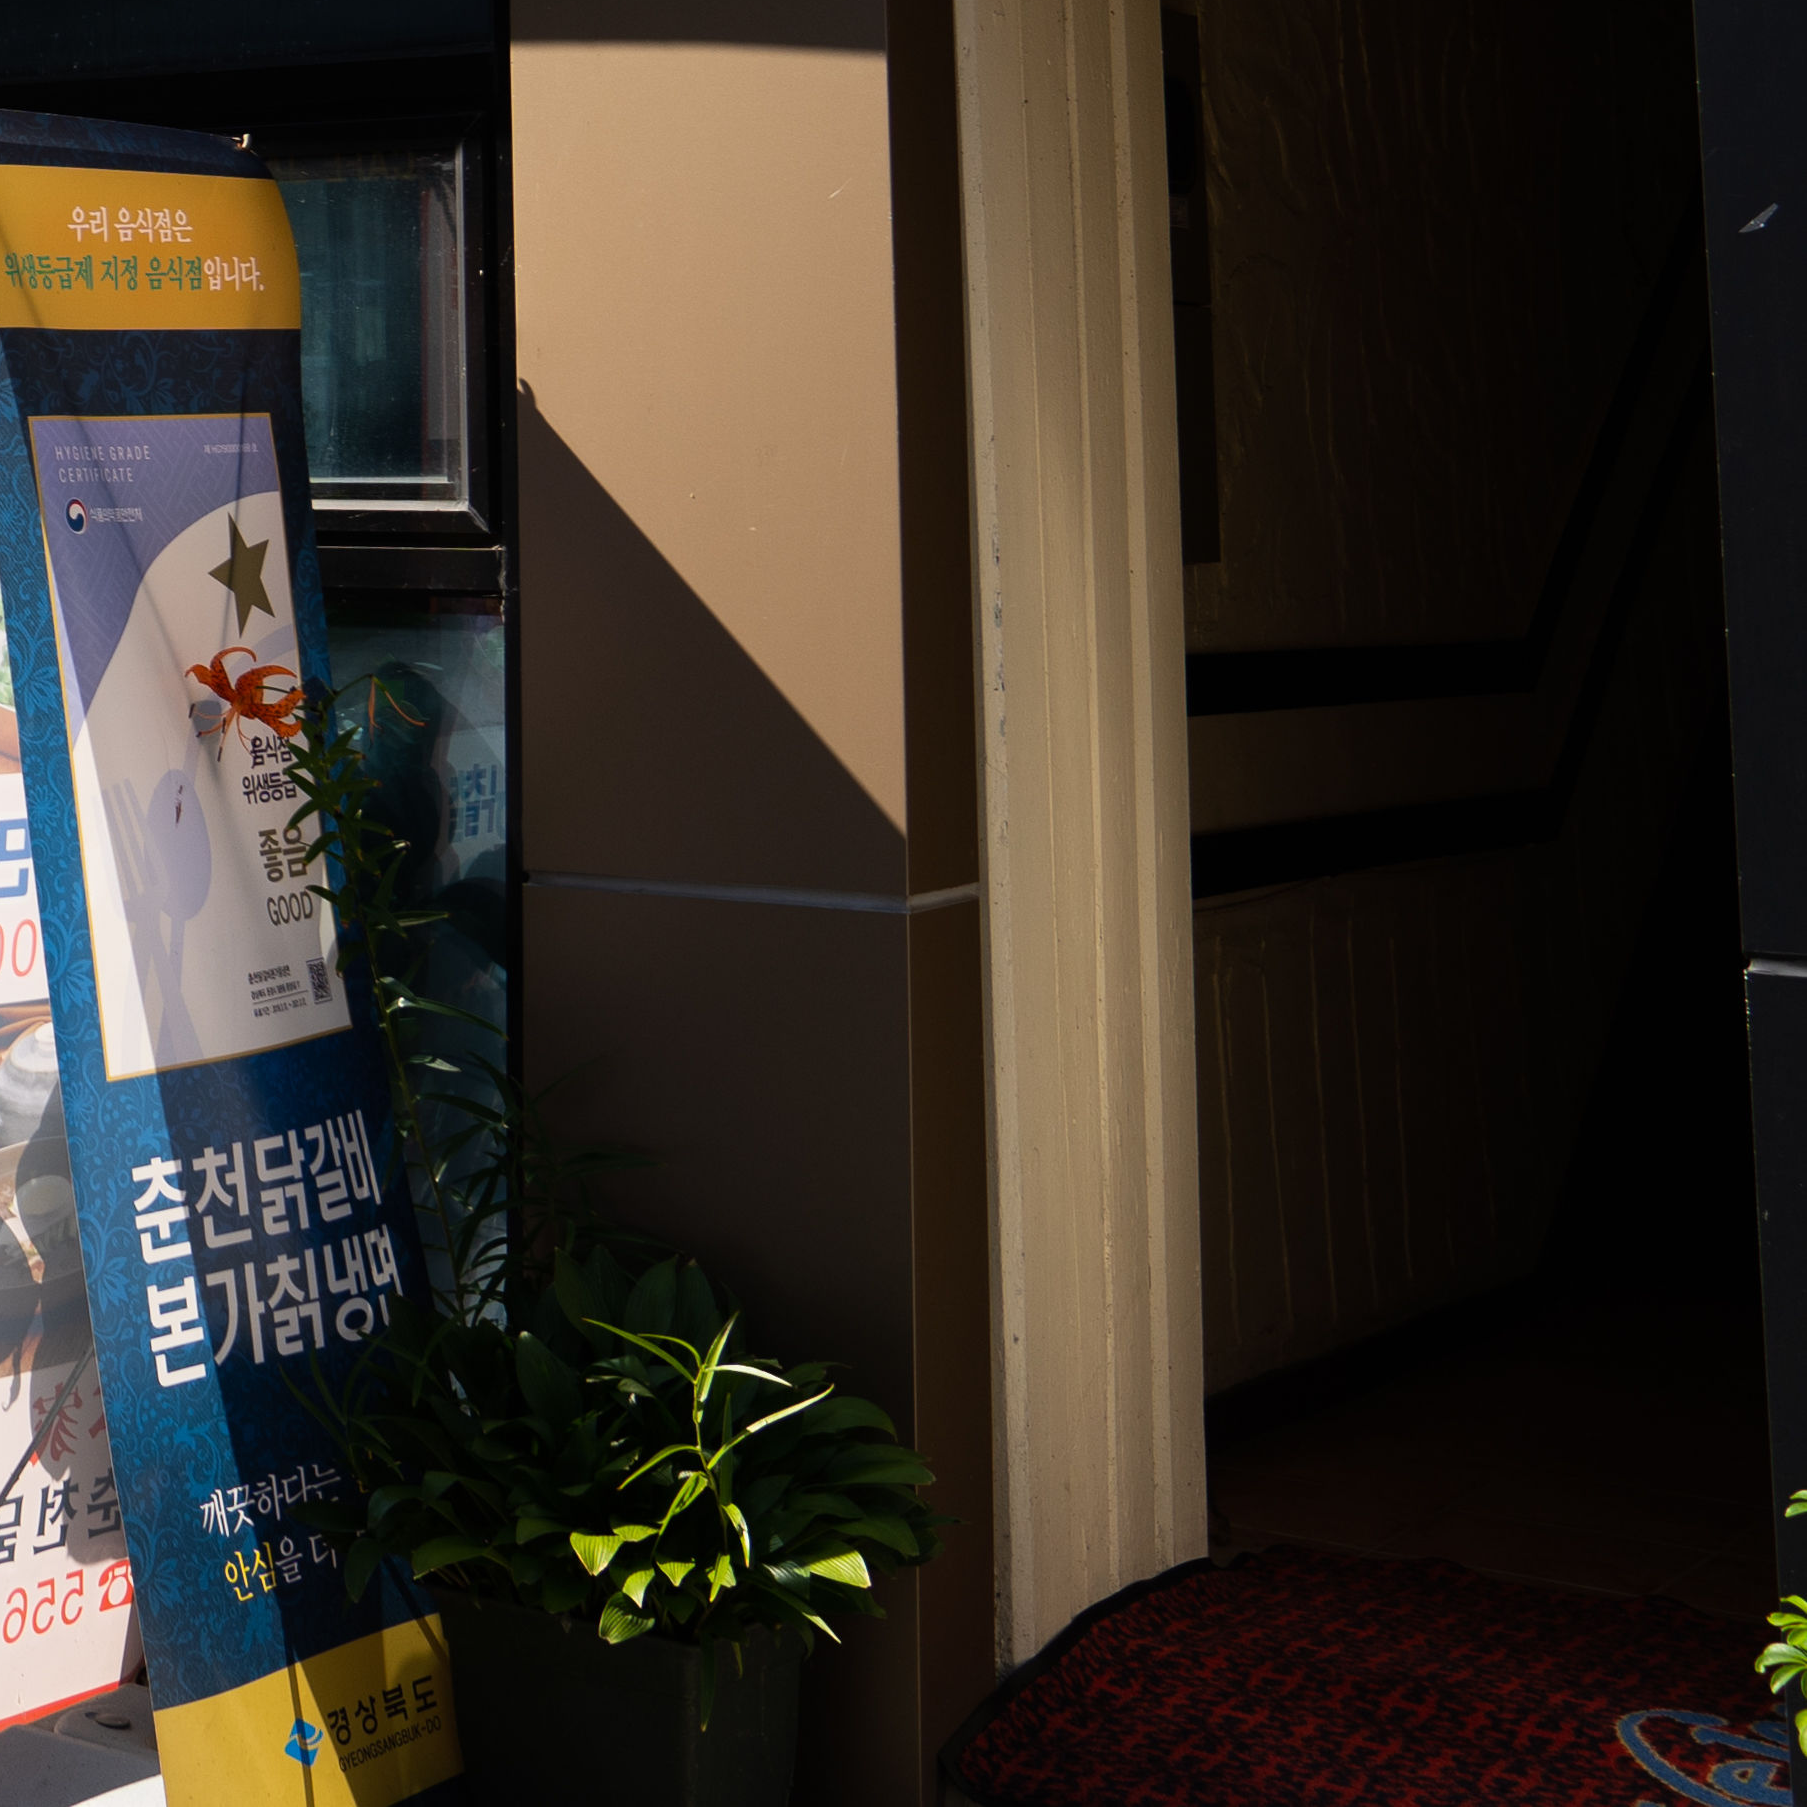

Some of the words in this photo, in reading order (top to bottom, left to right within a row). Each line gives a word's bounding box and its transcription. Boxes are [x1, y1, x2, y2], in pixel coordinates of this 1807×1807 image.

[67, 207, 108, 243] 우리
[114, 207, 193, 243] 음식점은
[3, 254, 92, 291] 위생등급제
[100, 255, 139, 291] 지정
[145, 256, 264, 292] 음식점입니다.
[55, 444, 104, 462] HYGIENE
[108, 444, 151, 462] GRADE
[58, 467, 134, 484] CERTIFICATE
[251, 734, 292, 768] 음식점
[258, 825, 307, 883] 좋음
[267, 891, 314, 926] GOOD
[132, 1110, 382, 1262] 춘천닭갈비
[224, 1536, 302, 1602] 안심을
[328, 1675, 437, 1745] 경상북도
[339, 1715, 442, 1772] GYEONGSANGBUK-DO
